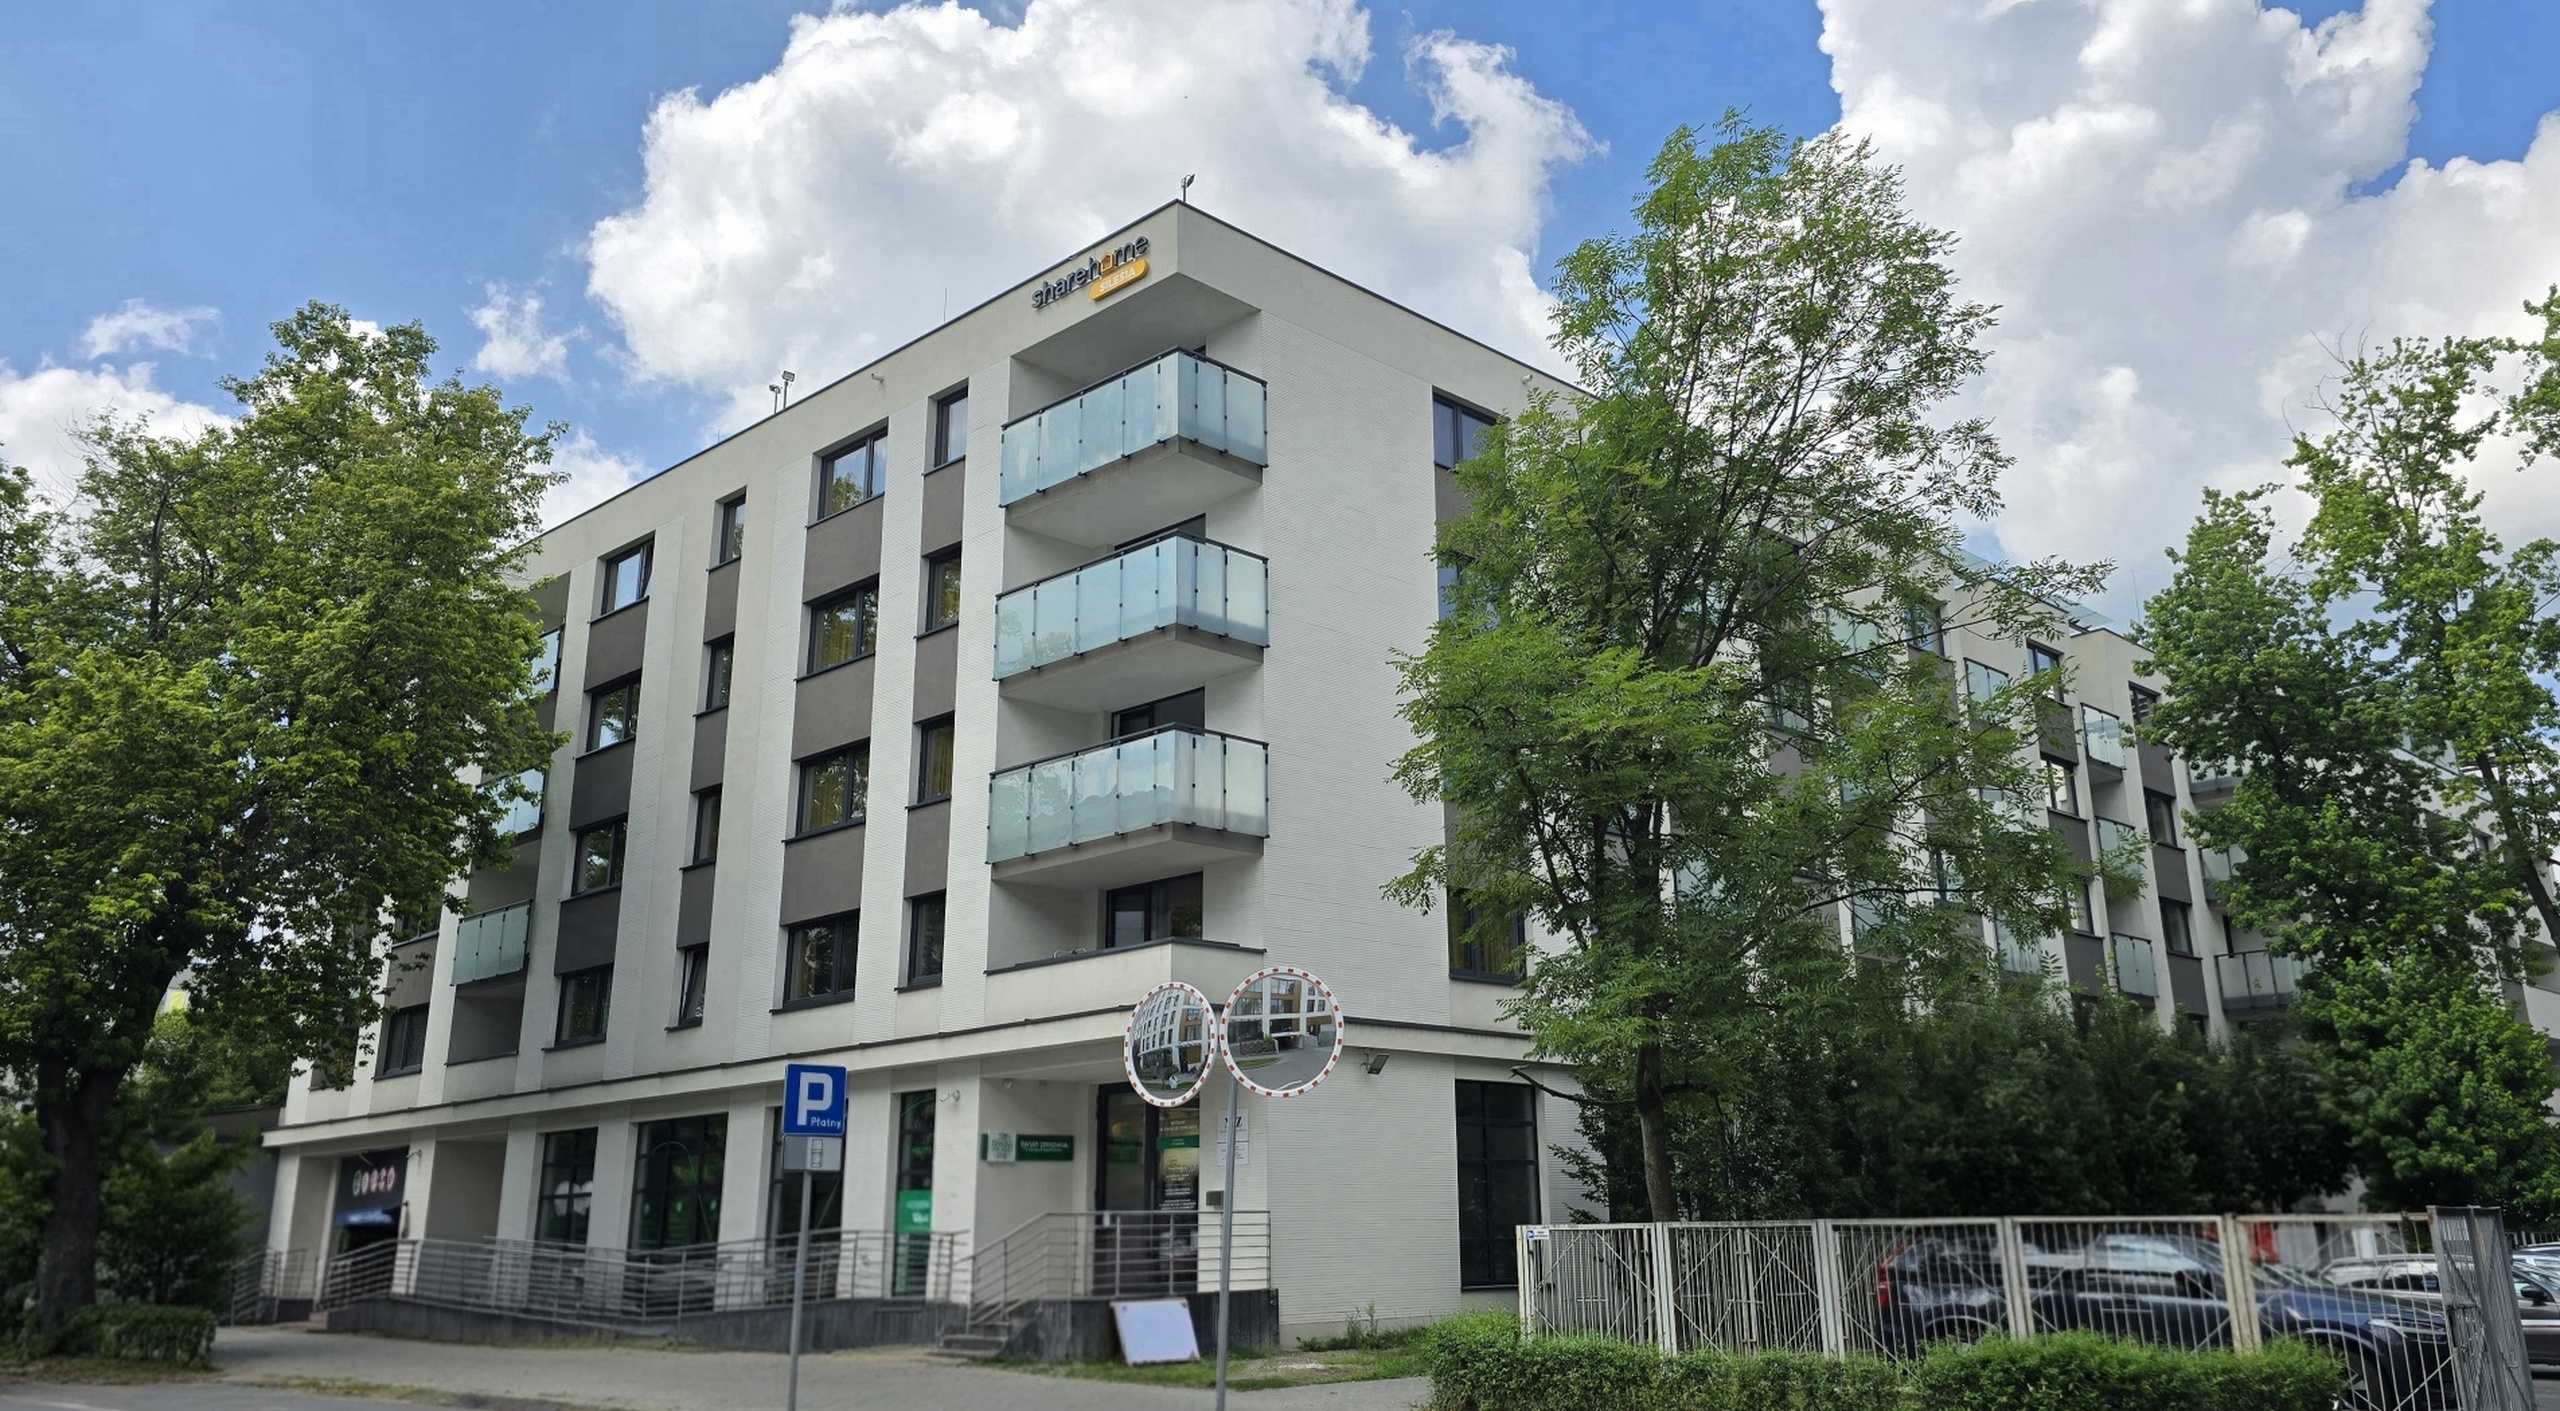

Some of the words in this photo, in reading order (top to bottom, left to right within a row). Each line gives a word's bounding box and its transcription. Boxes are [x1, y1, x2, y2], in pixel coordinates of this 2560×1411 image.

[1099, 266, 1136, 293] SILESIA
[797, 1072, 833, 1126] P
[811, 1116, 842, 1130] Płatny
